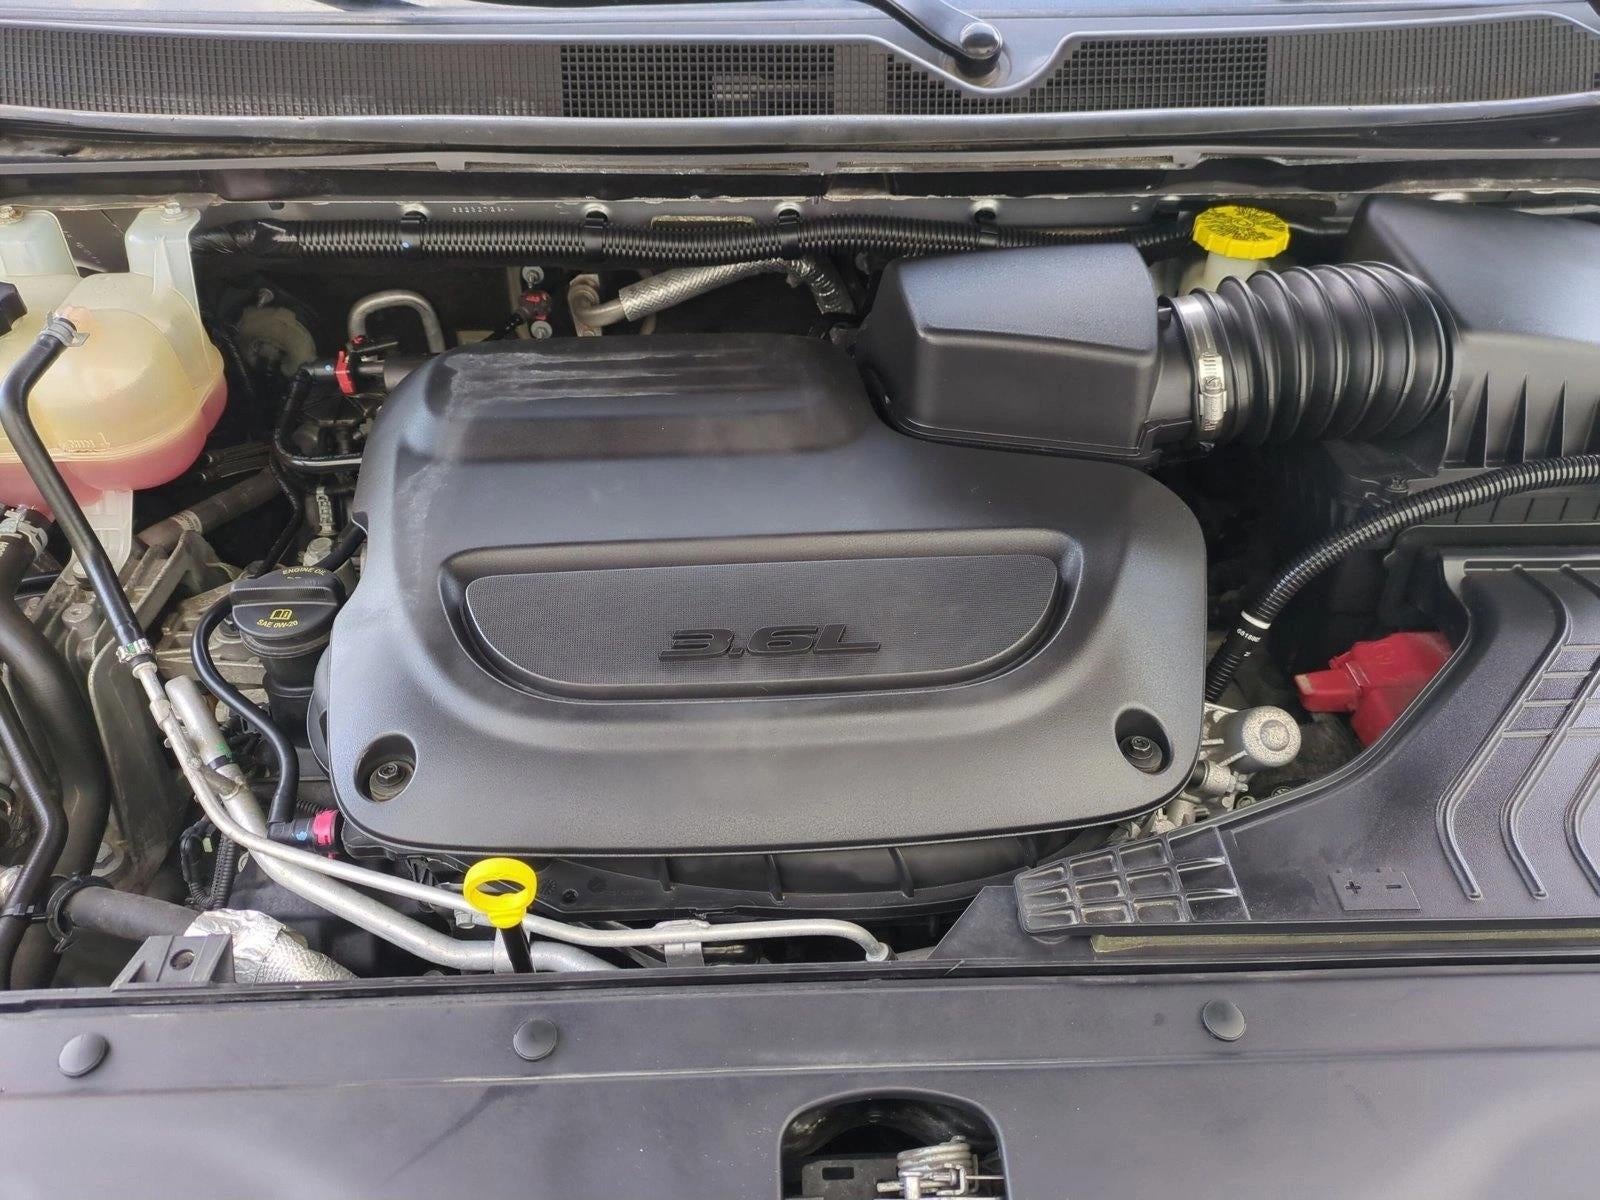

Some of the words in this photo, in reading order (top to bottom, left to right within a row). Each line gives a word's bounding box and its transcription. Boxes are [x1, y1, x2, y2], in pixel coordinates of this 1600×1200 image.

[282, 567, 315, 575] ENGINE
[256, 619, 273, 628] SAE
[273, 620, 299, 628] 0W-20
[658, 623, 881, 661] 3.6L
